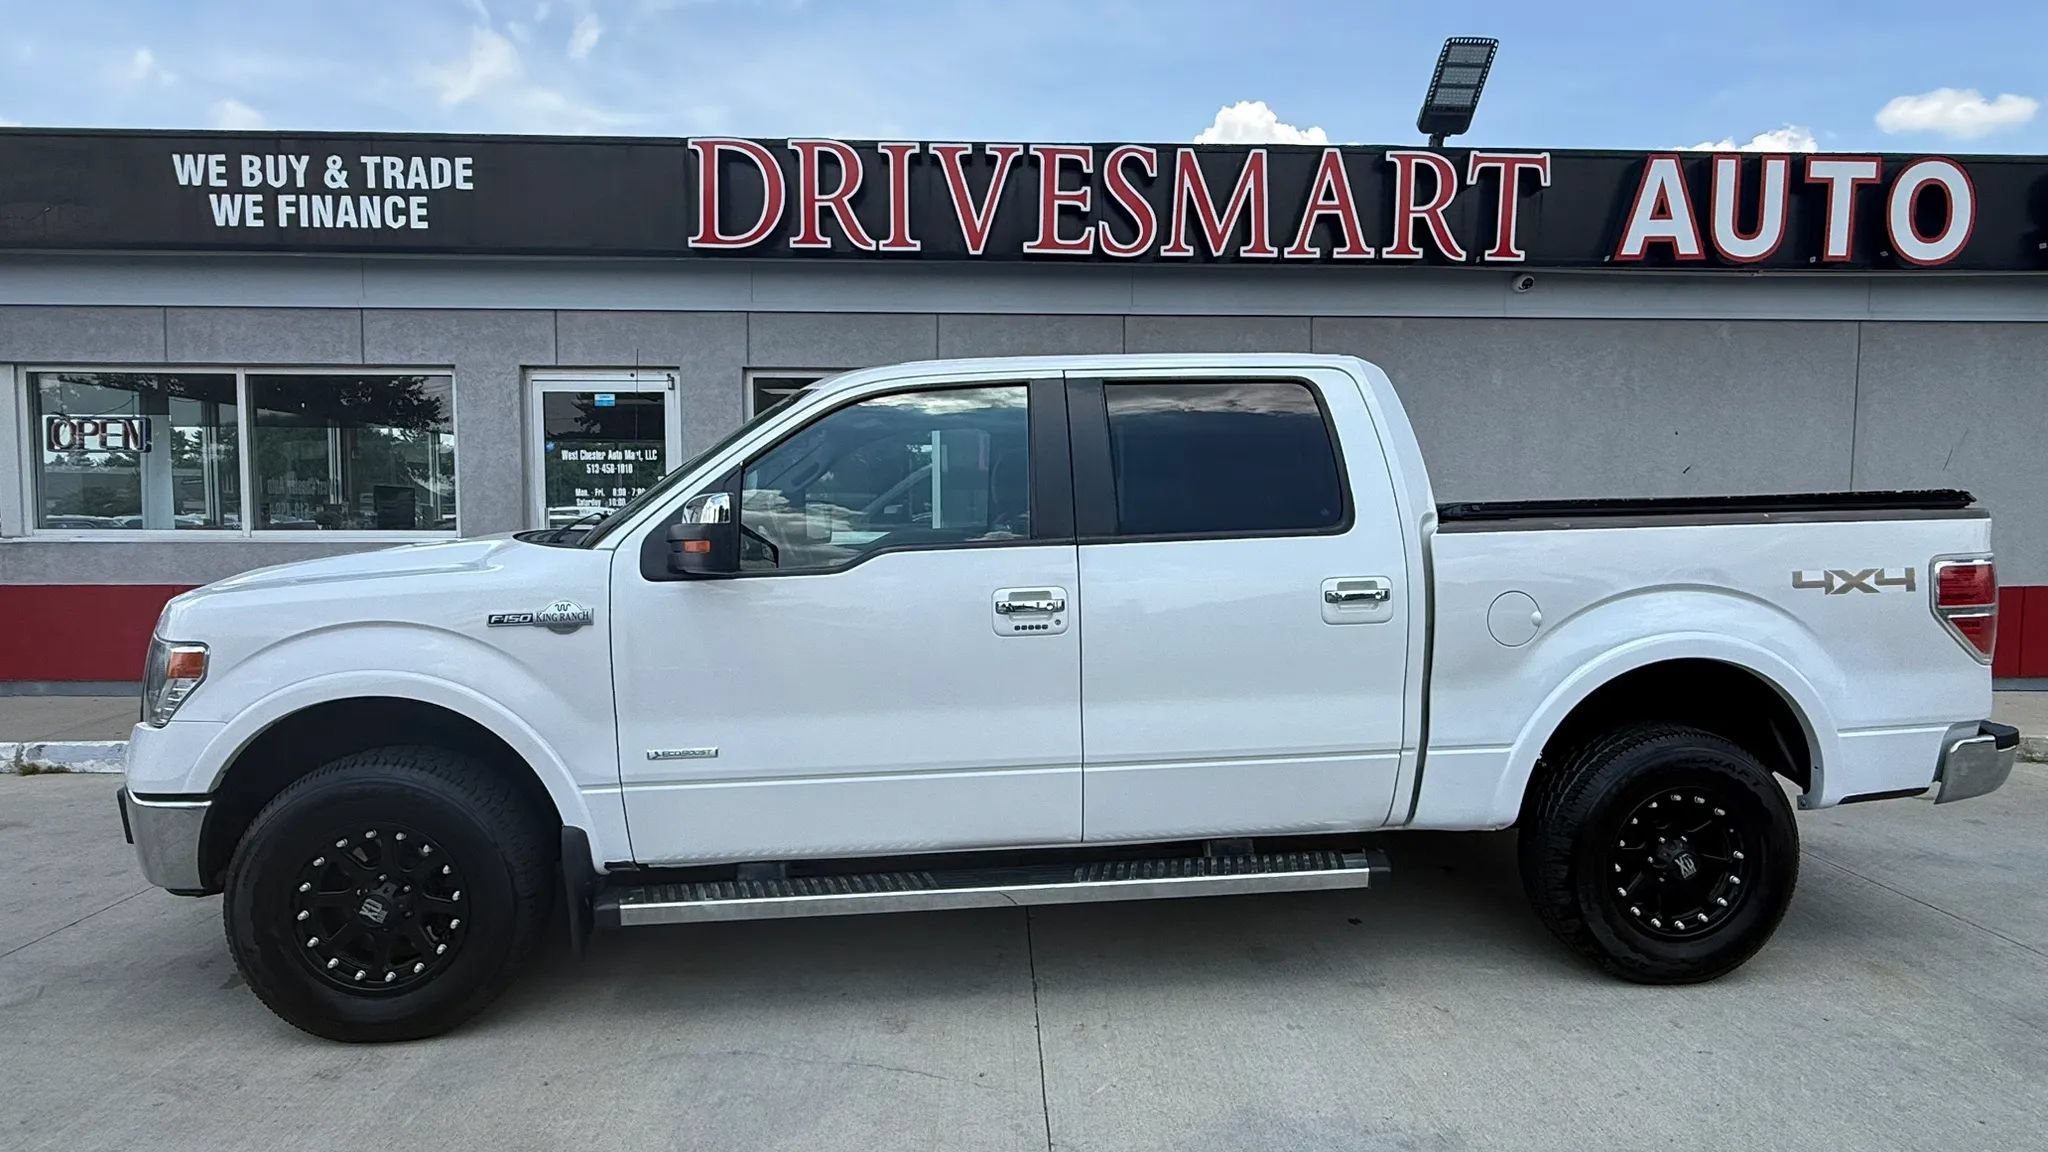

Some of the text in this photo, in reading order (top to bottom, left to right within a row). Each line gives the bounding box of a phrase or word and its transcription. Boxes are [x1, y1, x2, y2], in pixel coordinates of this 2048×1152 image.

[172, 154, 474, 190] WE BUY & TRADE
[208, 193, 429, 229] WE FINANCE
[686, 137, 1977, 266] DRIVESMART AUTO
[51, 419, 145, 451] OPEN
[561, 449, 579, 461] West
[579, 449, 606, 461] Chester
[607, 449, 623, 461] Auto
[645, 449, 658, 461] LLC
[1792, 567, 1916, 595] 4X4
[536, 611, 558, 623] KING
[560, 610, 589, 622] RANCH
